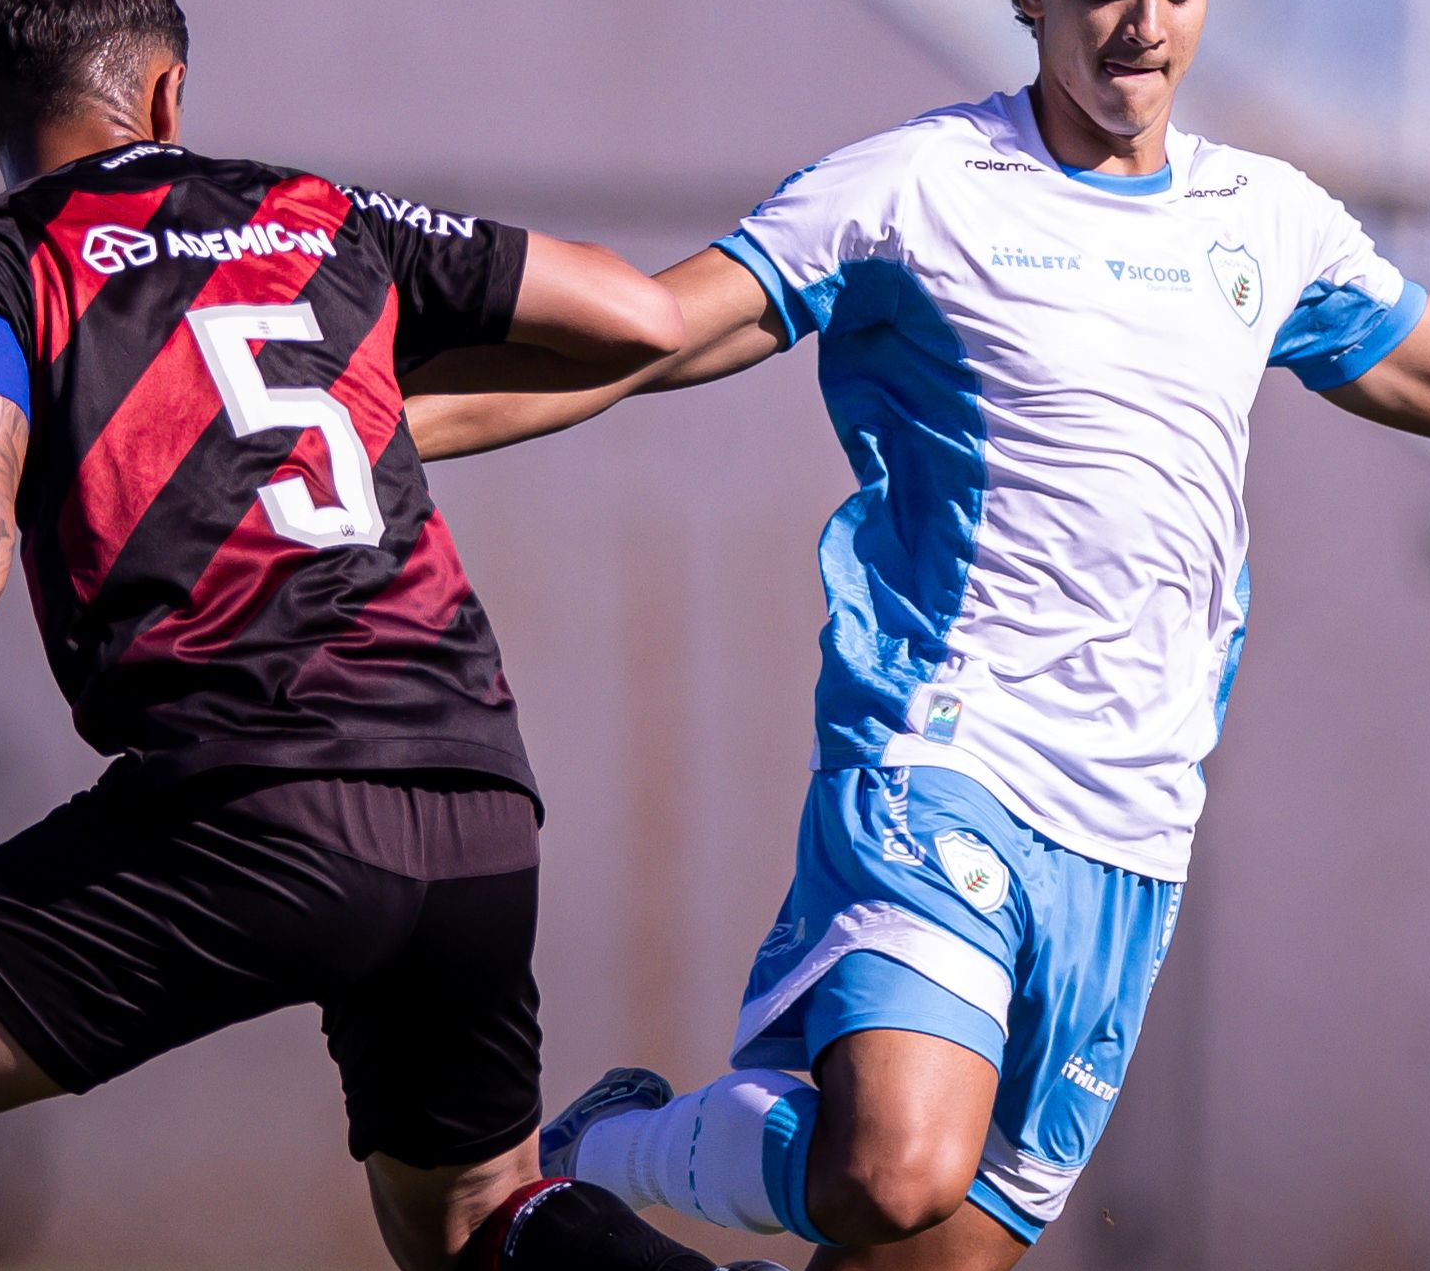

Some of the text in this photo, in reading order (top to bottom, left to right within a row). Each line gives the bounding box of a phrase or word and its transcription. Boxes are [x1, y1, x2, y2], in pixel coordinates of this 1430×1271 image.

[101, 145, 184, 169] umb
[991, 253, 1081, 270] ATHLETA
[1128, 265, 1191, 283] SICOOB
[185, 303, 386, 548] 5
